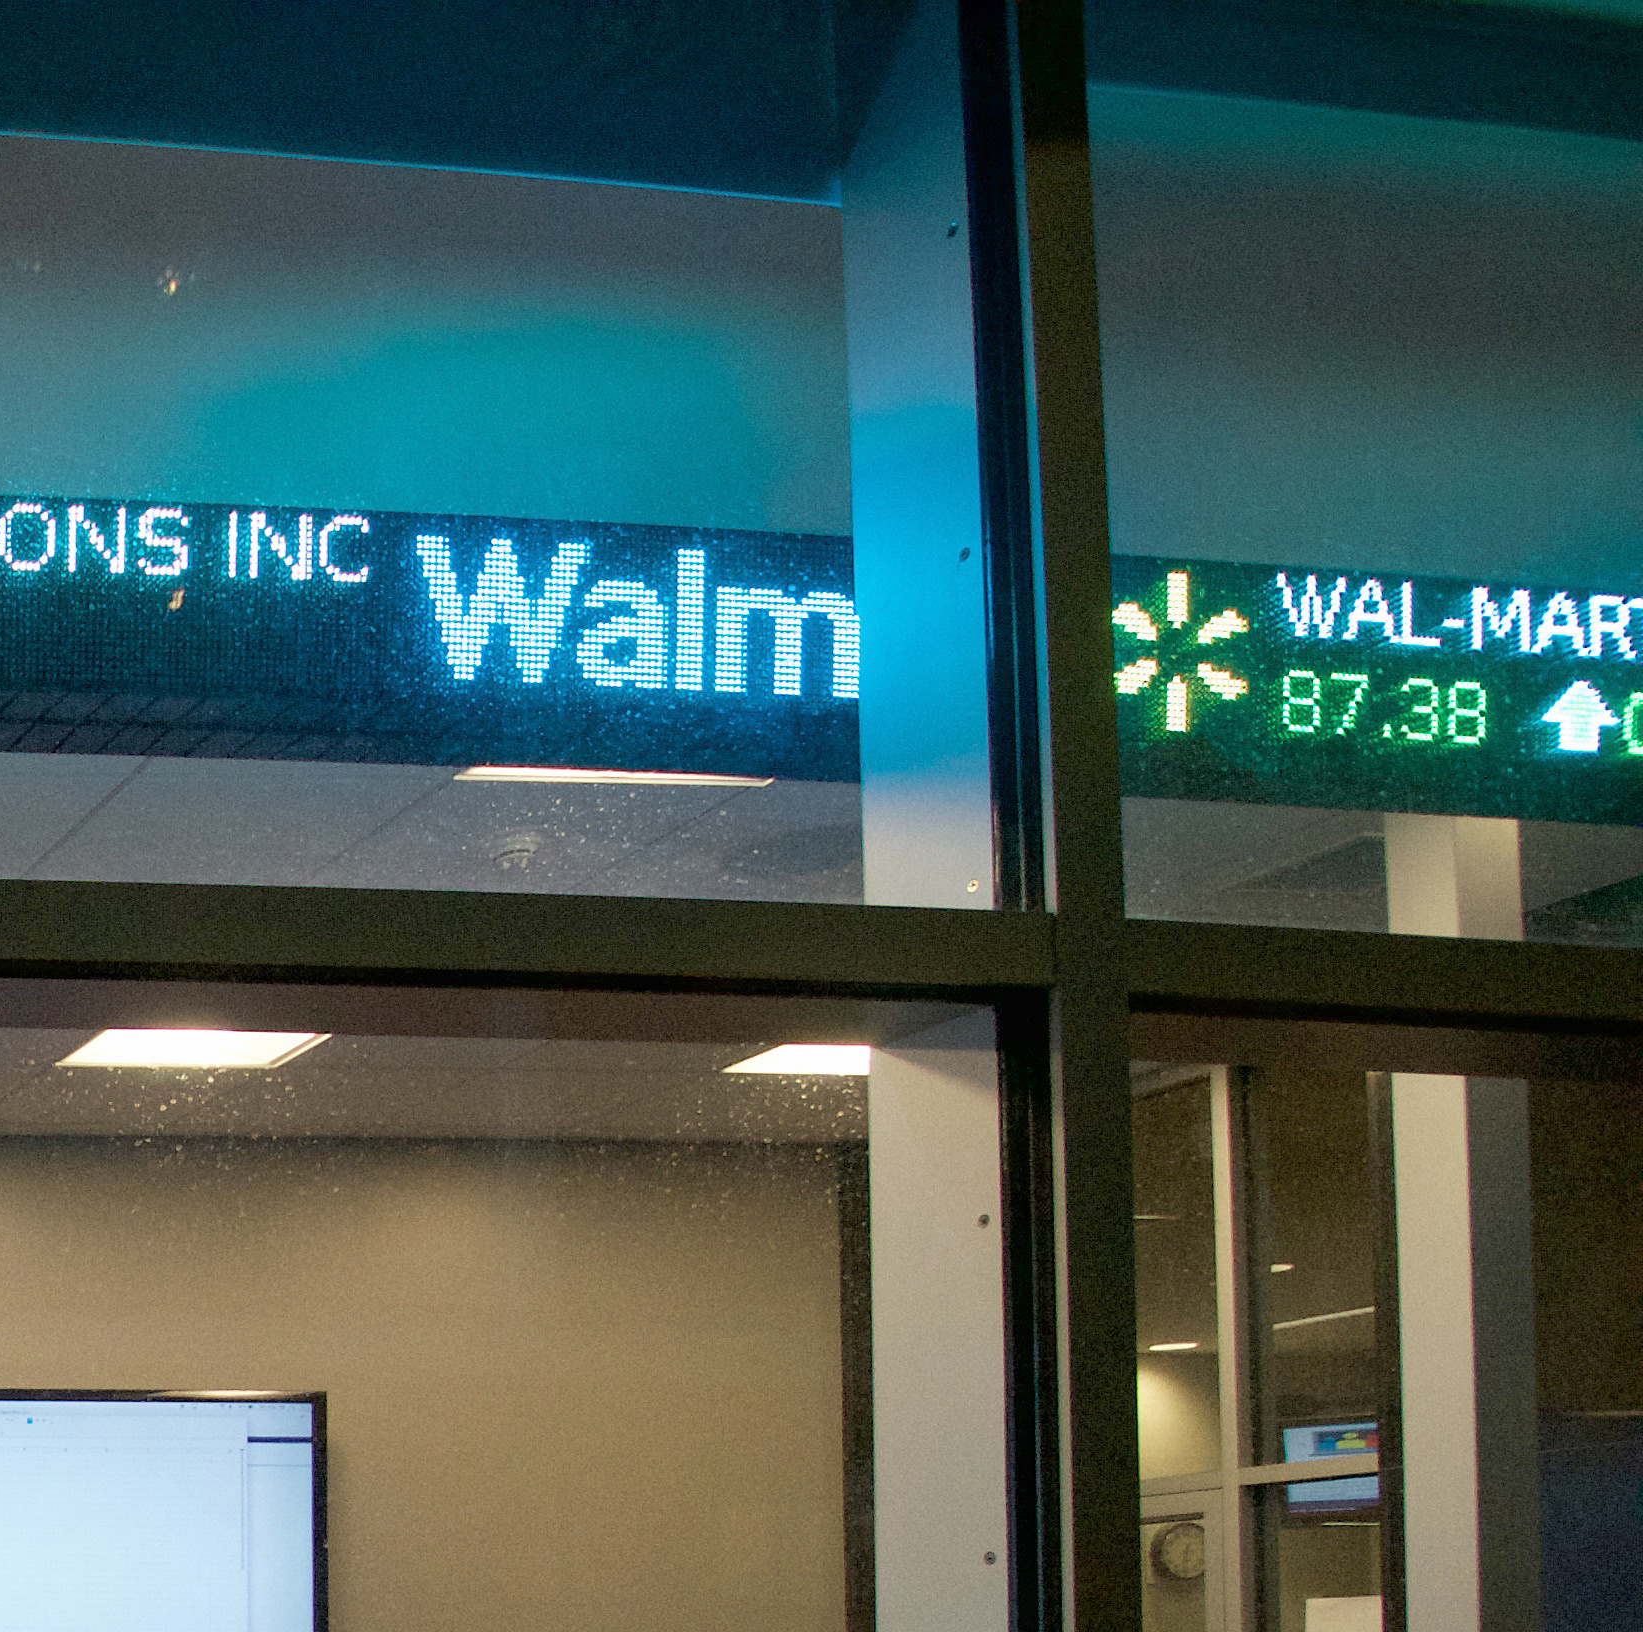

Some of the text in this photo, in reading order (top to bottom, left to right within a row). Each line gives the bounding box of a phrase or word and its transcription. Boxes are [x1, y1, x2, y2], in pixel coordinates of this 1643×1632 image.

[229, 509, 372, 583] INC
[416, 534, 860, 698] Walm
[1276, 571, 1643, 660] WAL-MAR
[1282, 669, 1487, 746] 87.38
